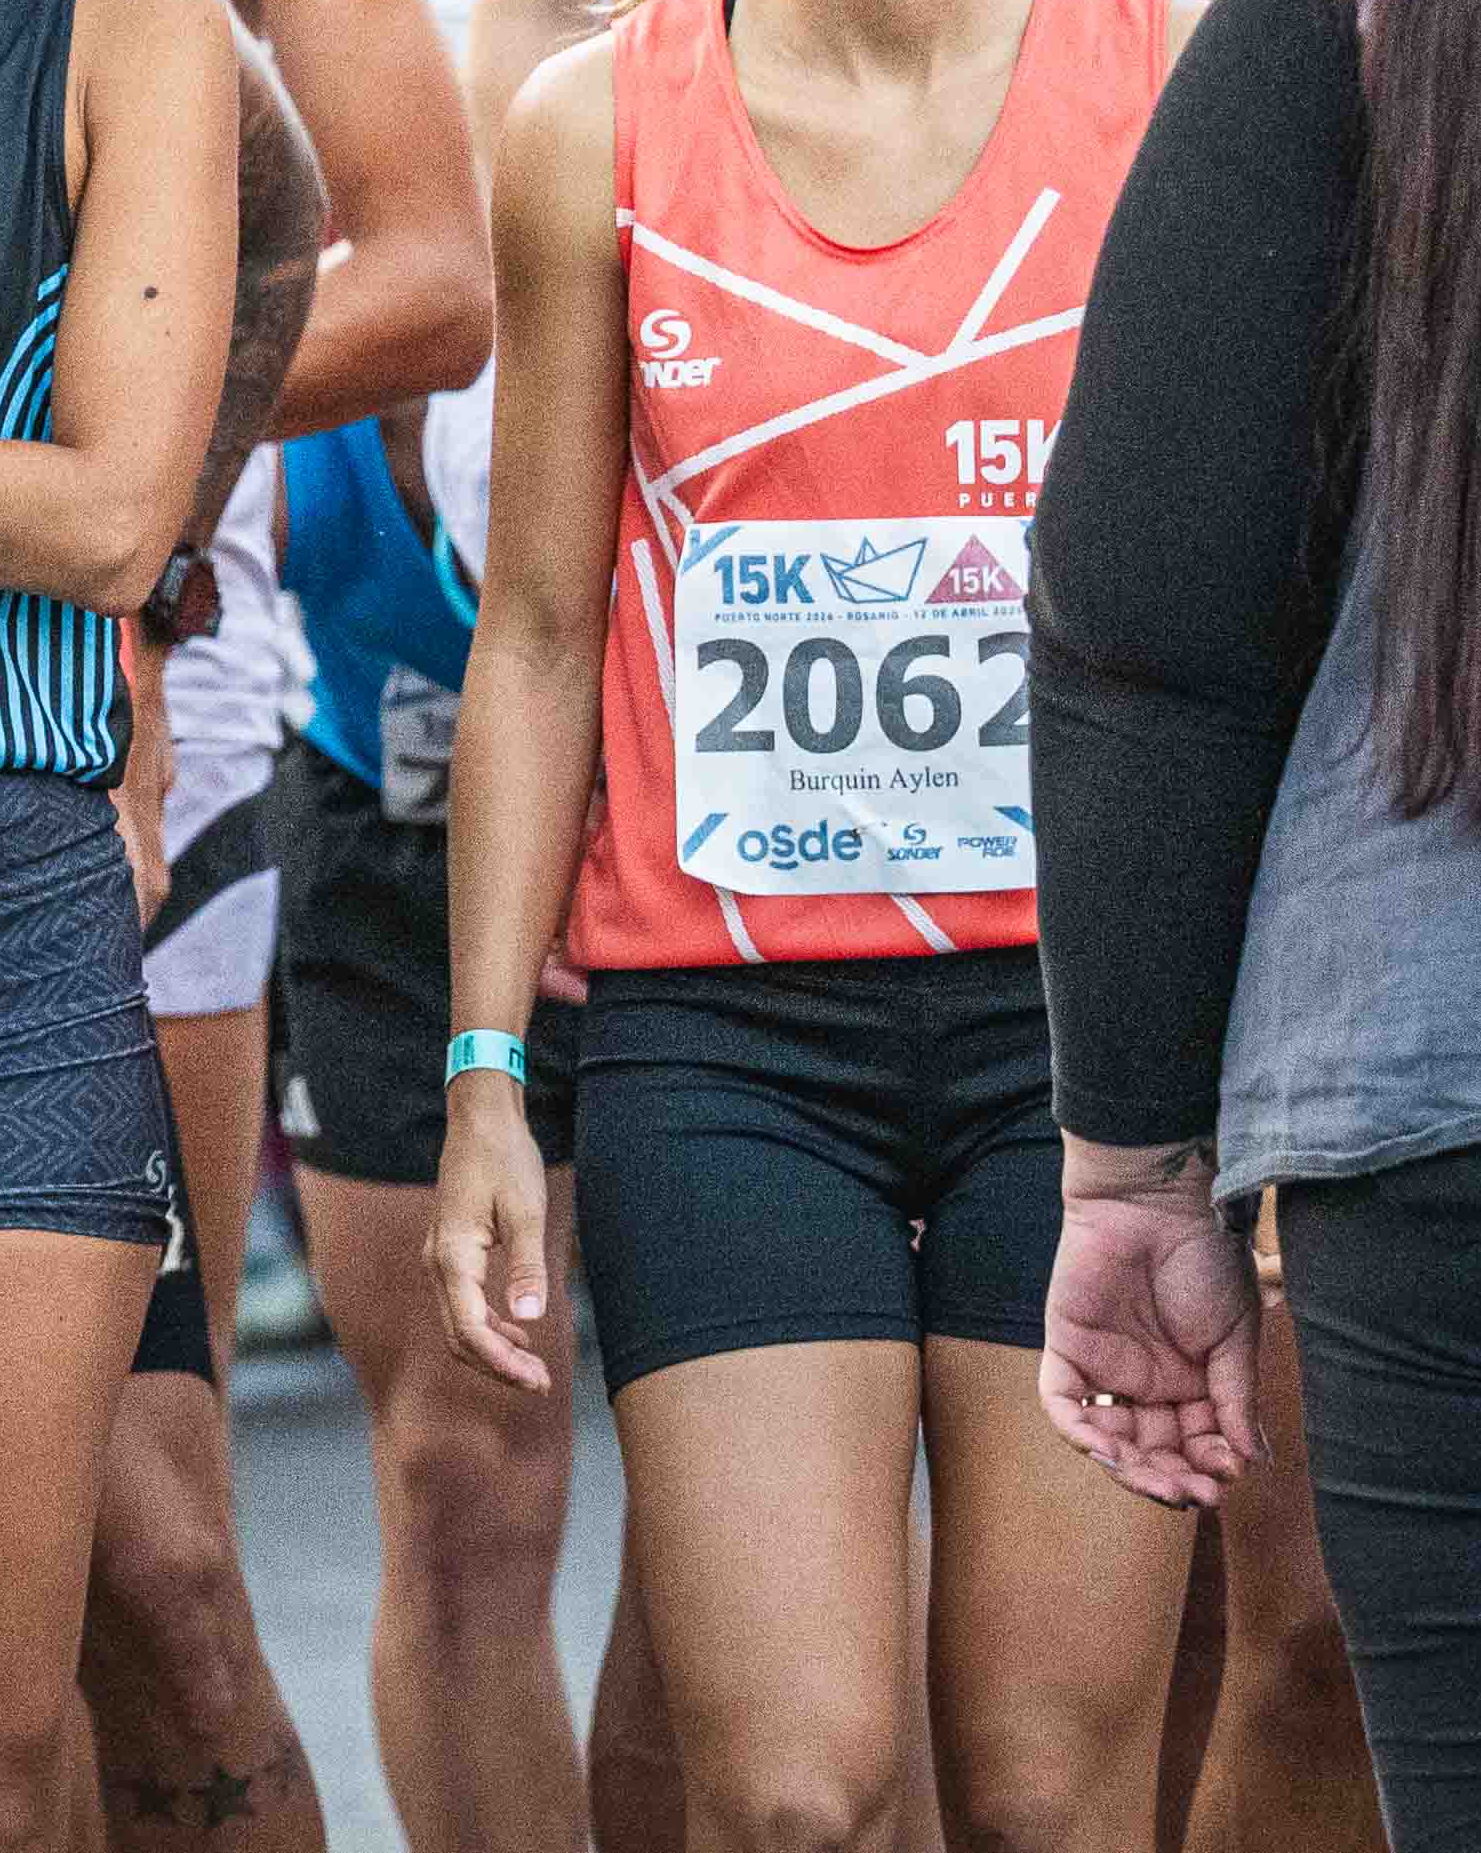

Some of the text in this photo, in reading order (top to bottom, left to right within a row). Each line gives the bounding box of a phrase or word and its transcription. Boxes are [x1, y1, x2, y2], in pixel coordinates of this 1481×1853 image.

[959, 491, 1037, 509] PUER
[713, 554, 815, 605] 15K
[948, 567, 1005, 595] 15K
[714, 613, 761, 623] PUERTO
[764, 612, 801, 622] NORTE
[847, 611, 900, 622] ROSARIO
[695, 631, 1031, 754] 2062
[790, 766, 960, 795] Burquin Aylen
[737, 819, 863, 870] osde
